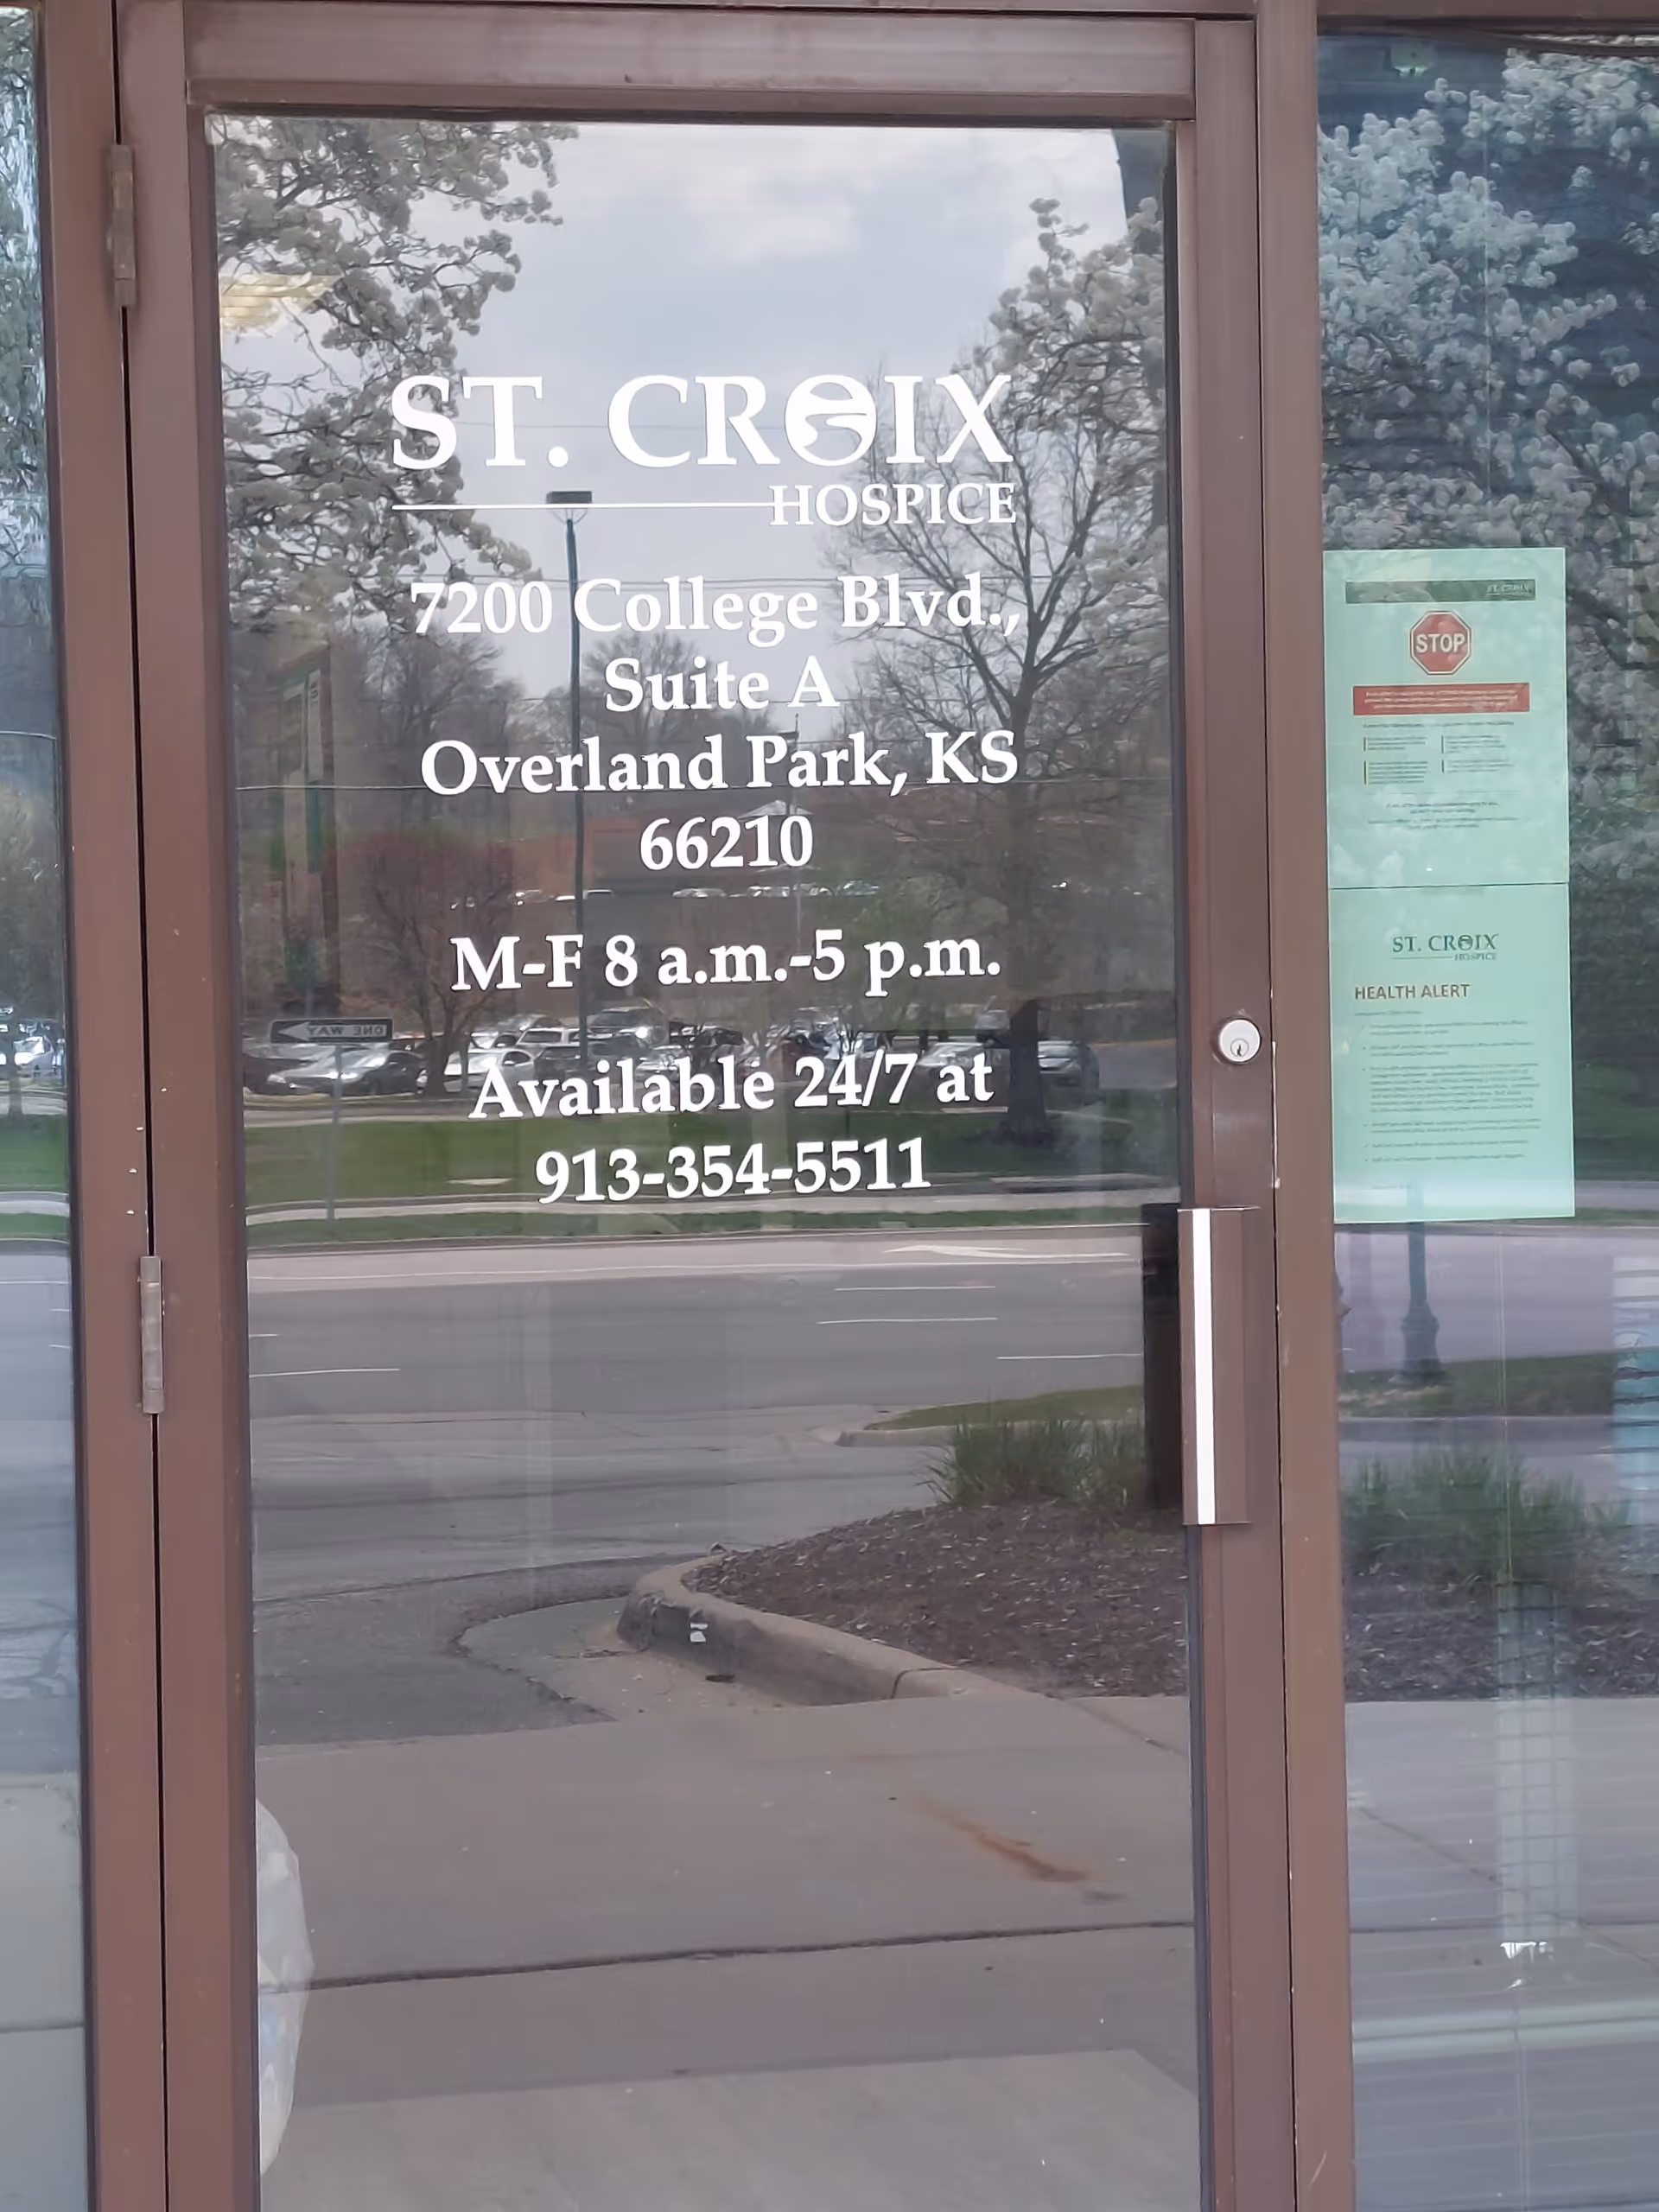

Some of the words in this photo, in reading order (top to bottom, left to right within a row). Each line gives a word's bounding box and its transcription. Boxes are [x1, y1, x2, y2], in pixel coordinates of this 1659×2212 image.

[391, 375, 569, 469] ST.
[608, 373, 1014, 468] CROIX
[768, 482, 1018, 526] HOSPICE
[410, 580, 553, 634] 7200
[574, 575, 817, 647] College
[838, 571, 1021, 637] Blvd.,
[1416, 632, 1465, 653] STOP
[606, 655, 770, 712] Suite
[787, 655, 841, 708] A
[422, 734, 728, 795] Overland
[746, 731, 907, 796] Park,
[925, 729, 1018, 784] KS
[640, 814, 813, 870] 66210
[450, 934, 583, 990] M-F
[605, 934, 638, 987] 8
[658, 929, 845, 985] a.m.-5
[864, 938, 1001, 996] p.m.
[1392, 936, 1421, 952] ST.
[1428, 934, 1499, 951] CROIX
[1355, 985, 1416, 1000] HEALTH
[1421, 983, 1471, 998] ALERT
[467, 1055, 774, 1118] Available
[794, 1048, 918, 1107] 24/7
[937, 1052, 995, 1103] at
[536, 1137, 931, 1204] 913-354-5511
